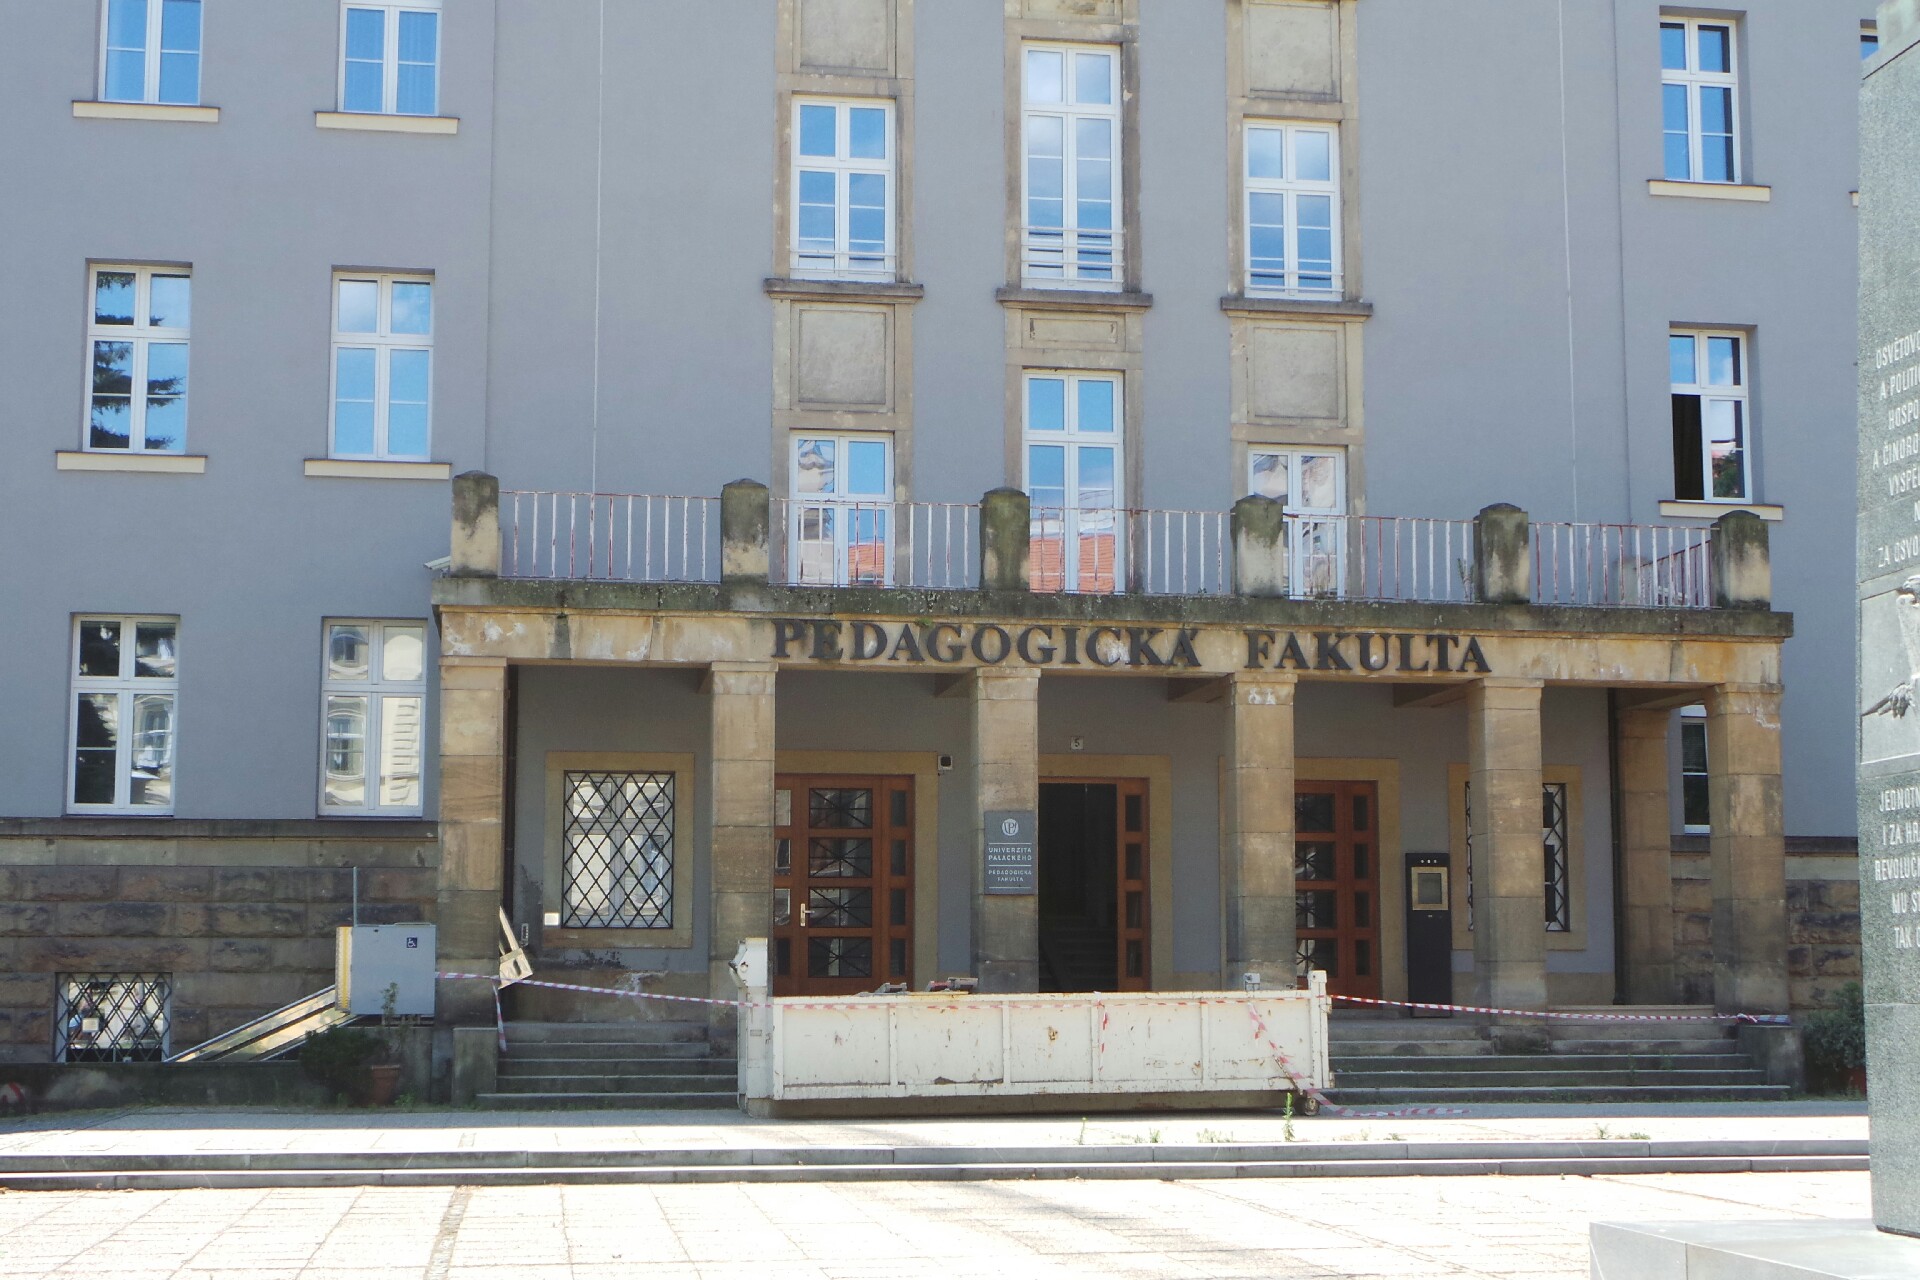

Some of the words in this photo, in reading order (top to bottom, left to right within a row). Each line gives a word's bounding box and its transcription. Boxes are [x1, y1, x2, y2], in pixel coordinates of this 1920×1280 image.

[1880, 380, 1888, 401] A
[1872, 449, 1880, 471] A
[1878, 544, 1891, 568] ZA
[771, 617, 1202, 667] PEDAGOGICKÁ
[1243, 629, 1492, 673] FAKULTA
[1074, 737, 1080, 748] 5
[1889, 823, 1903, 845] ZA
[1905, 820, 1920, 843] HR
